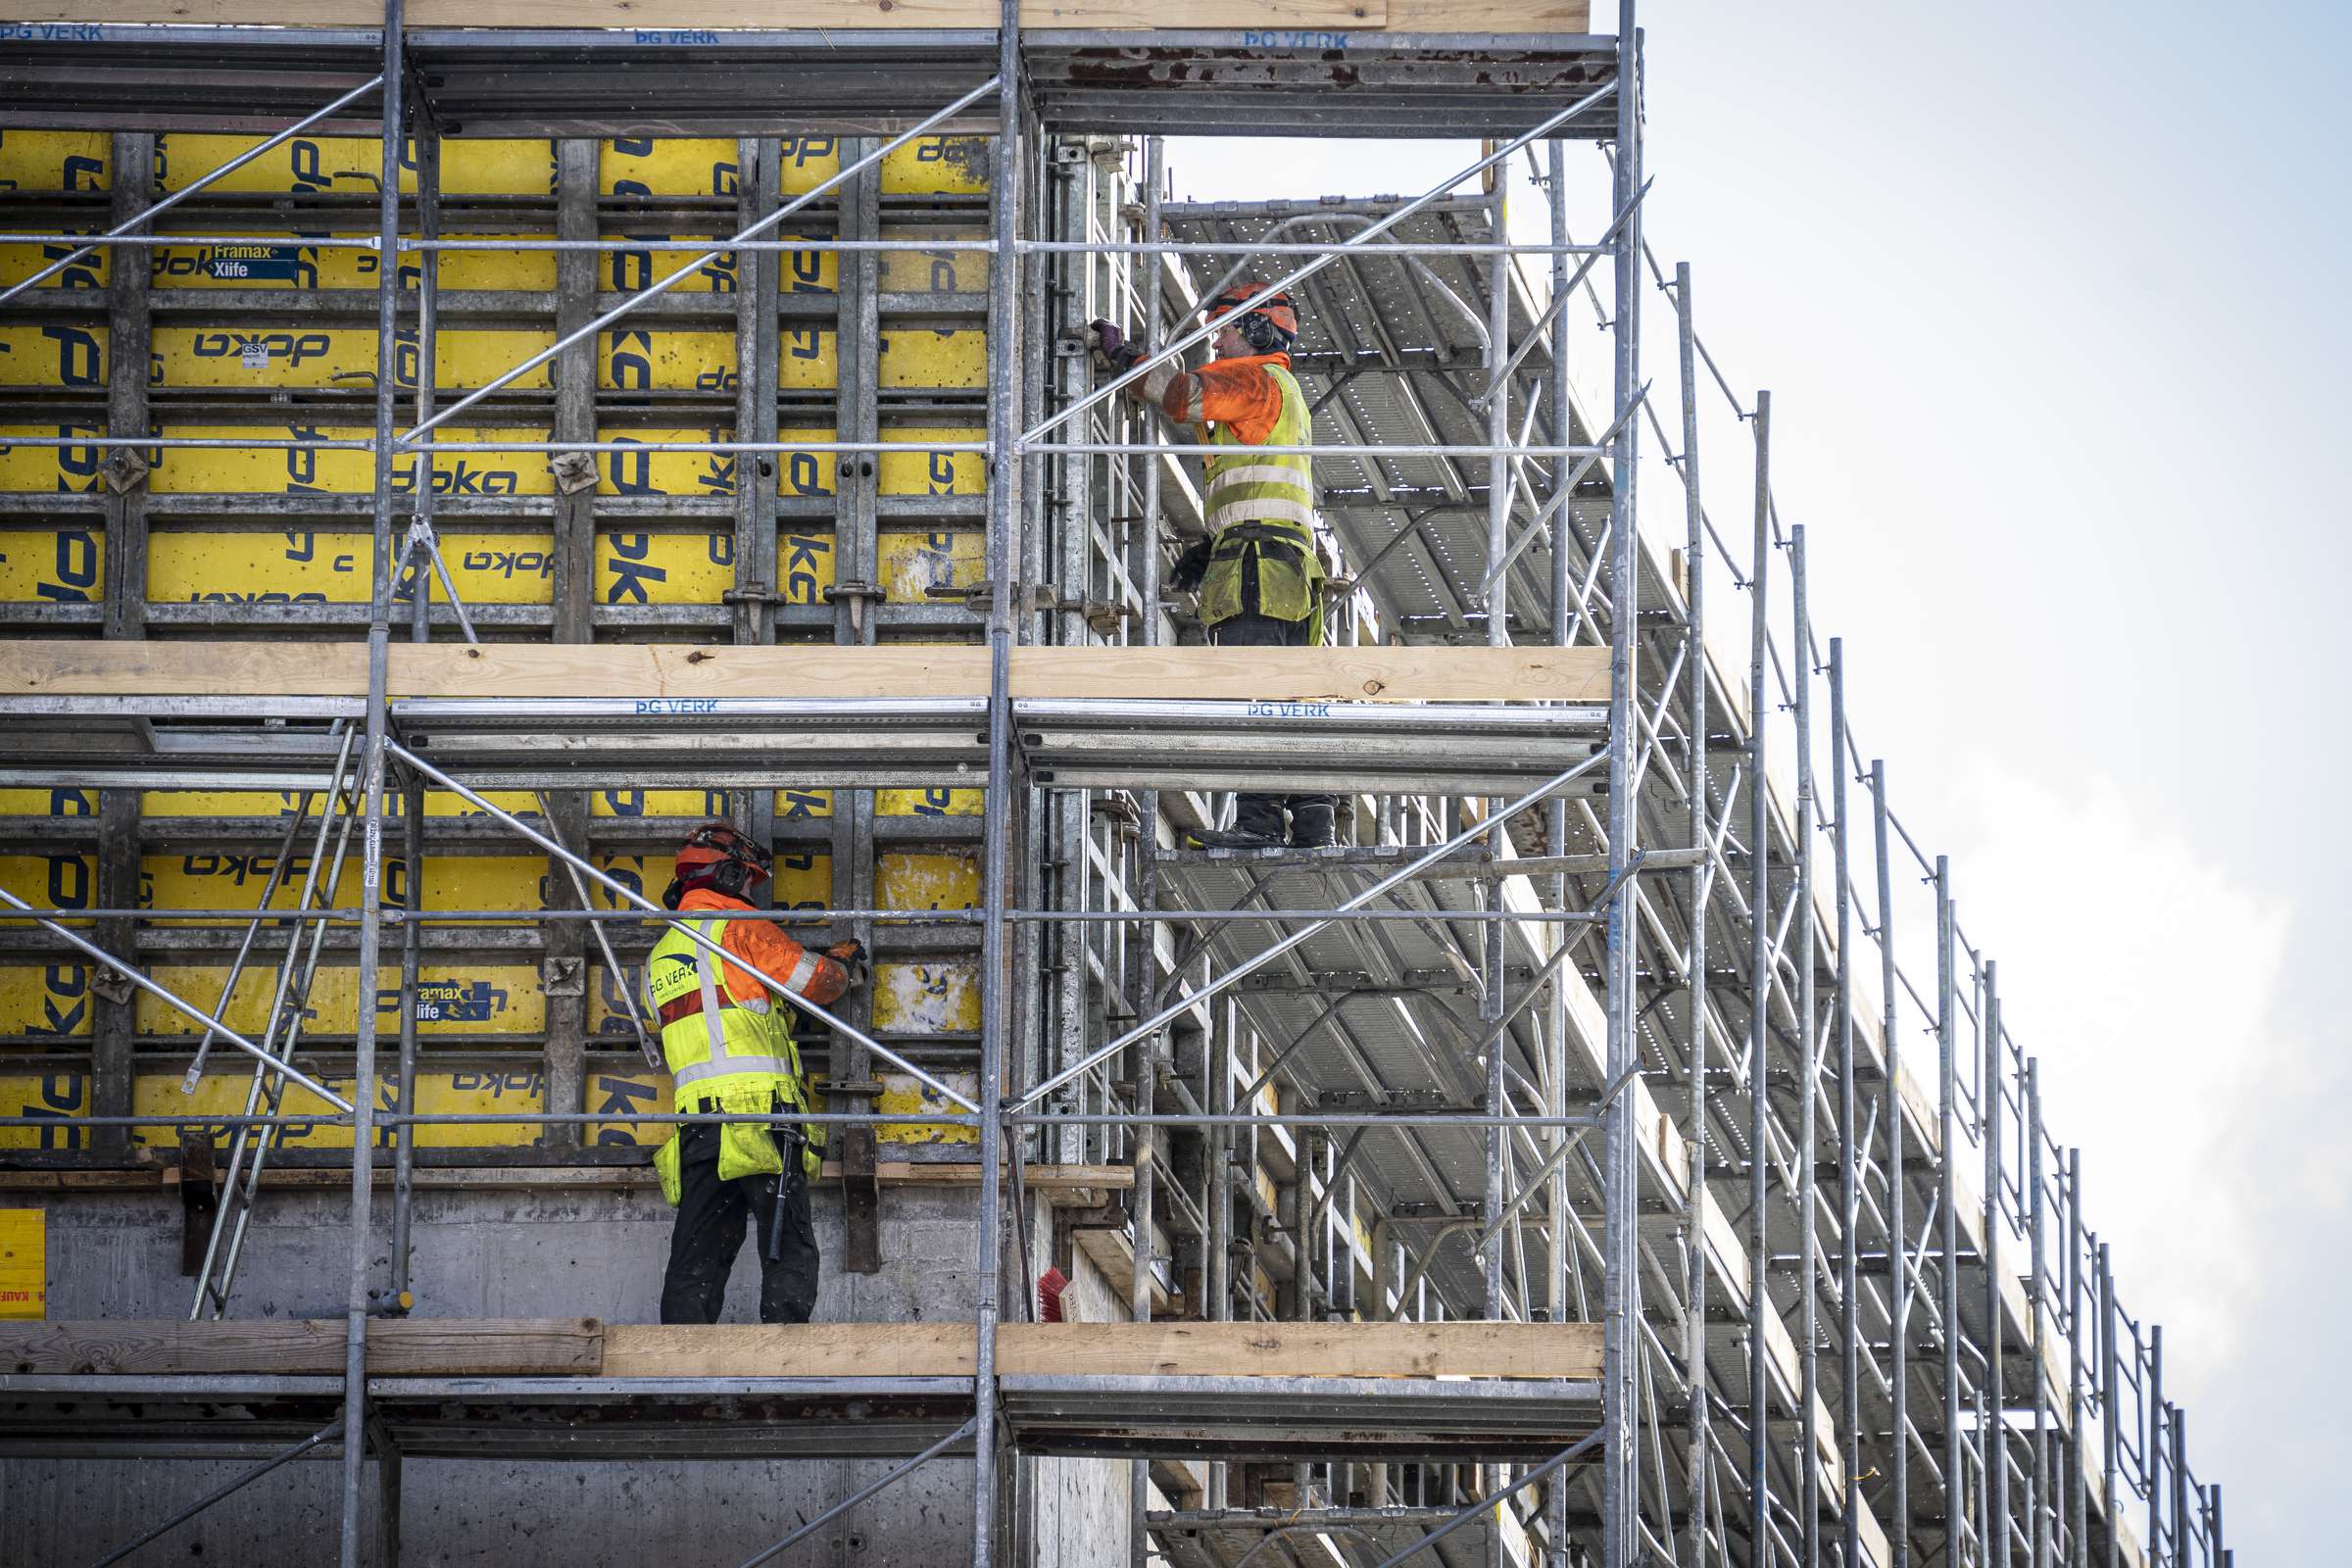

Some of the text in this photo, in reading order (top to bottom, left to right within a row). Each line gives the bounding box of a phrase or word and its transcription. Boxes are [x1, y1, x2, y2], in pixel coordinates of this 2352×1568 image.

[40, 24, 103, 40] VERK
[668, 30, 719, 44] VERK
[214, 245, 271, 259] Framax
[214, 262, 248, 277] Xlife
[242, 344, 268, 354] GSV
[667, 699, 718, 713] VERK
[1279, 704, 1330, 717] VERK
[665, 960, 699, 987] VERK
